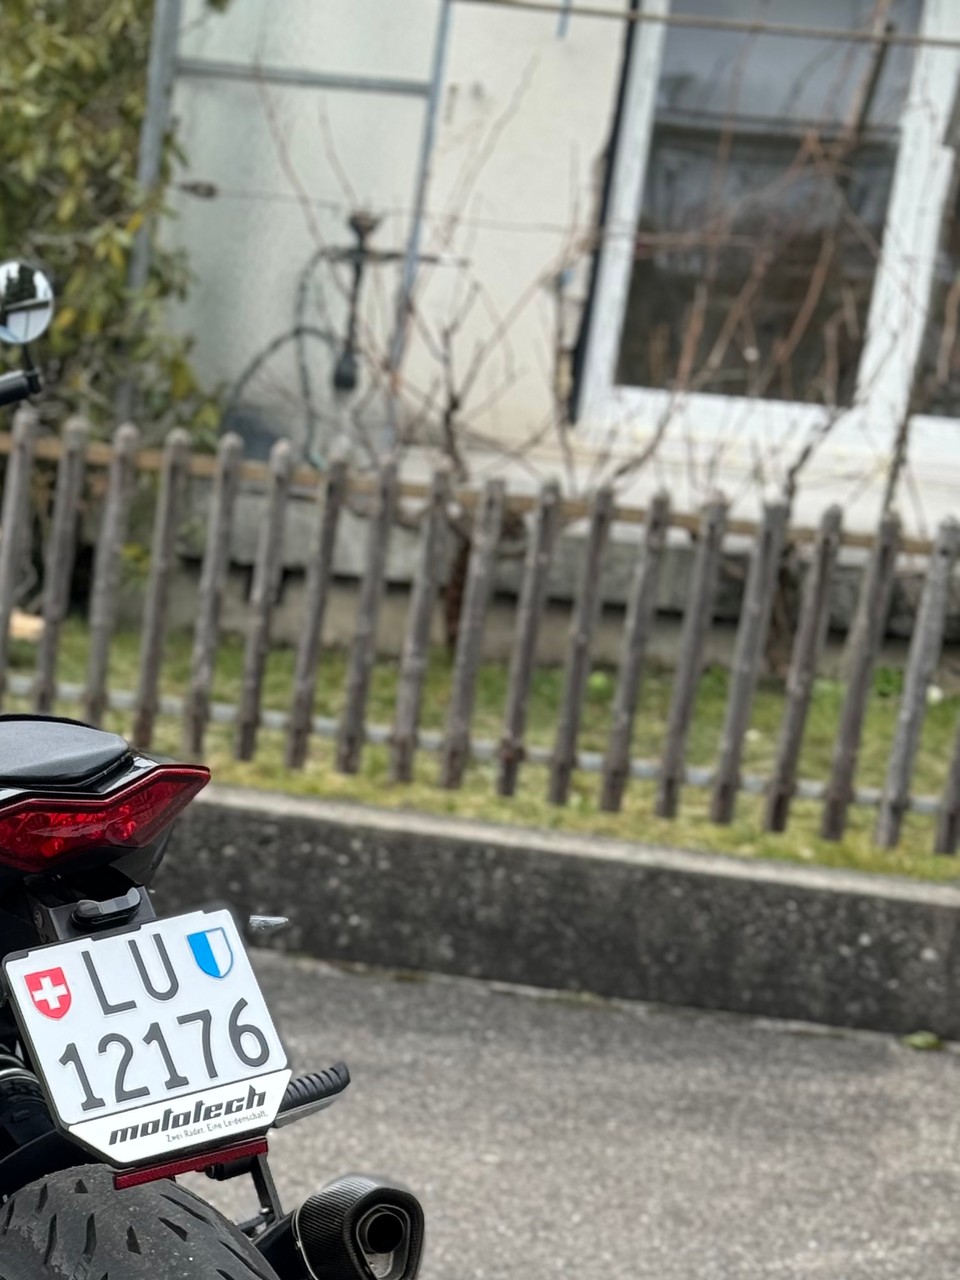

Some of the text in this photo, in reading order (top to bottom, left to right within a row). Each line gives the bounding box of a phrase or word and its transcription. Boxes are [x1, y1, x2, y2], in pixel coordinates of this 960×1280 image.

[81, 933, 179, 1015] LU
[58, 997, 270, 1111] 12176
[108, 1084, 267, 1145] mototech
